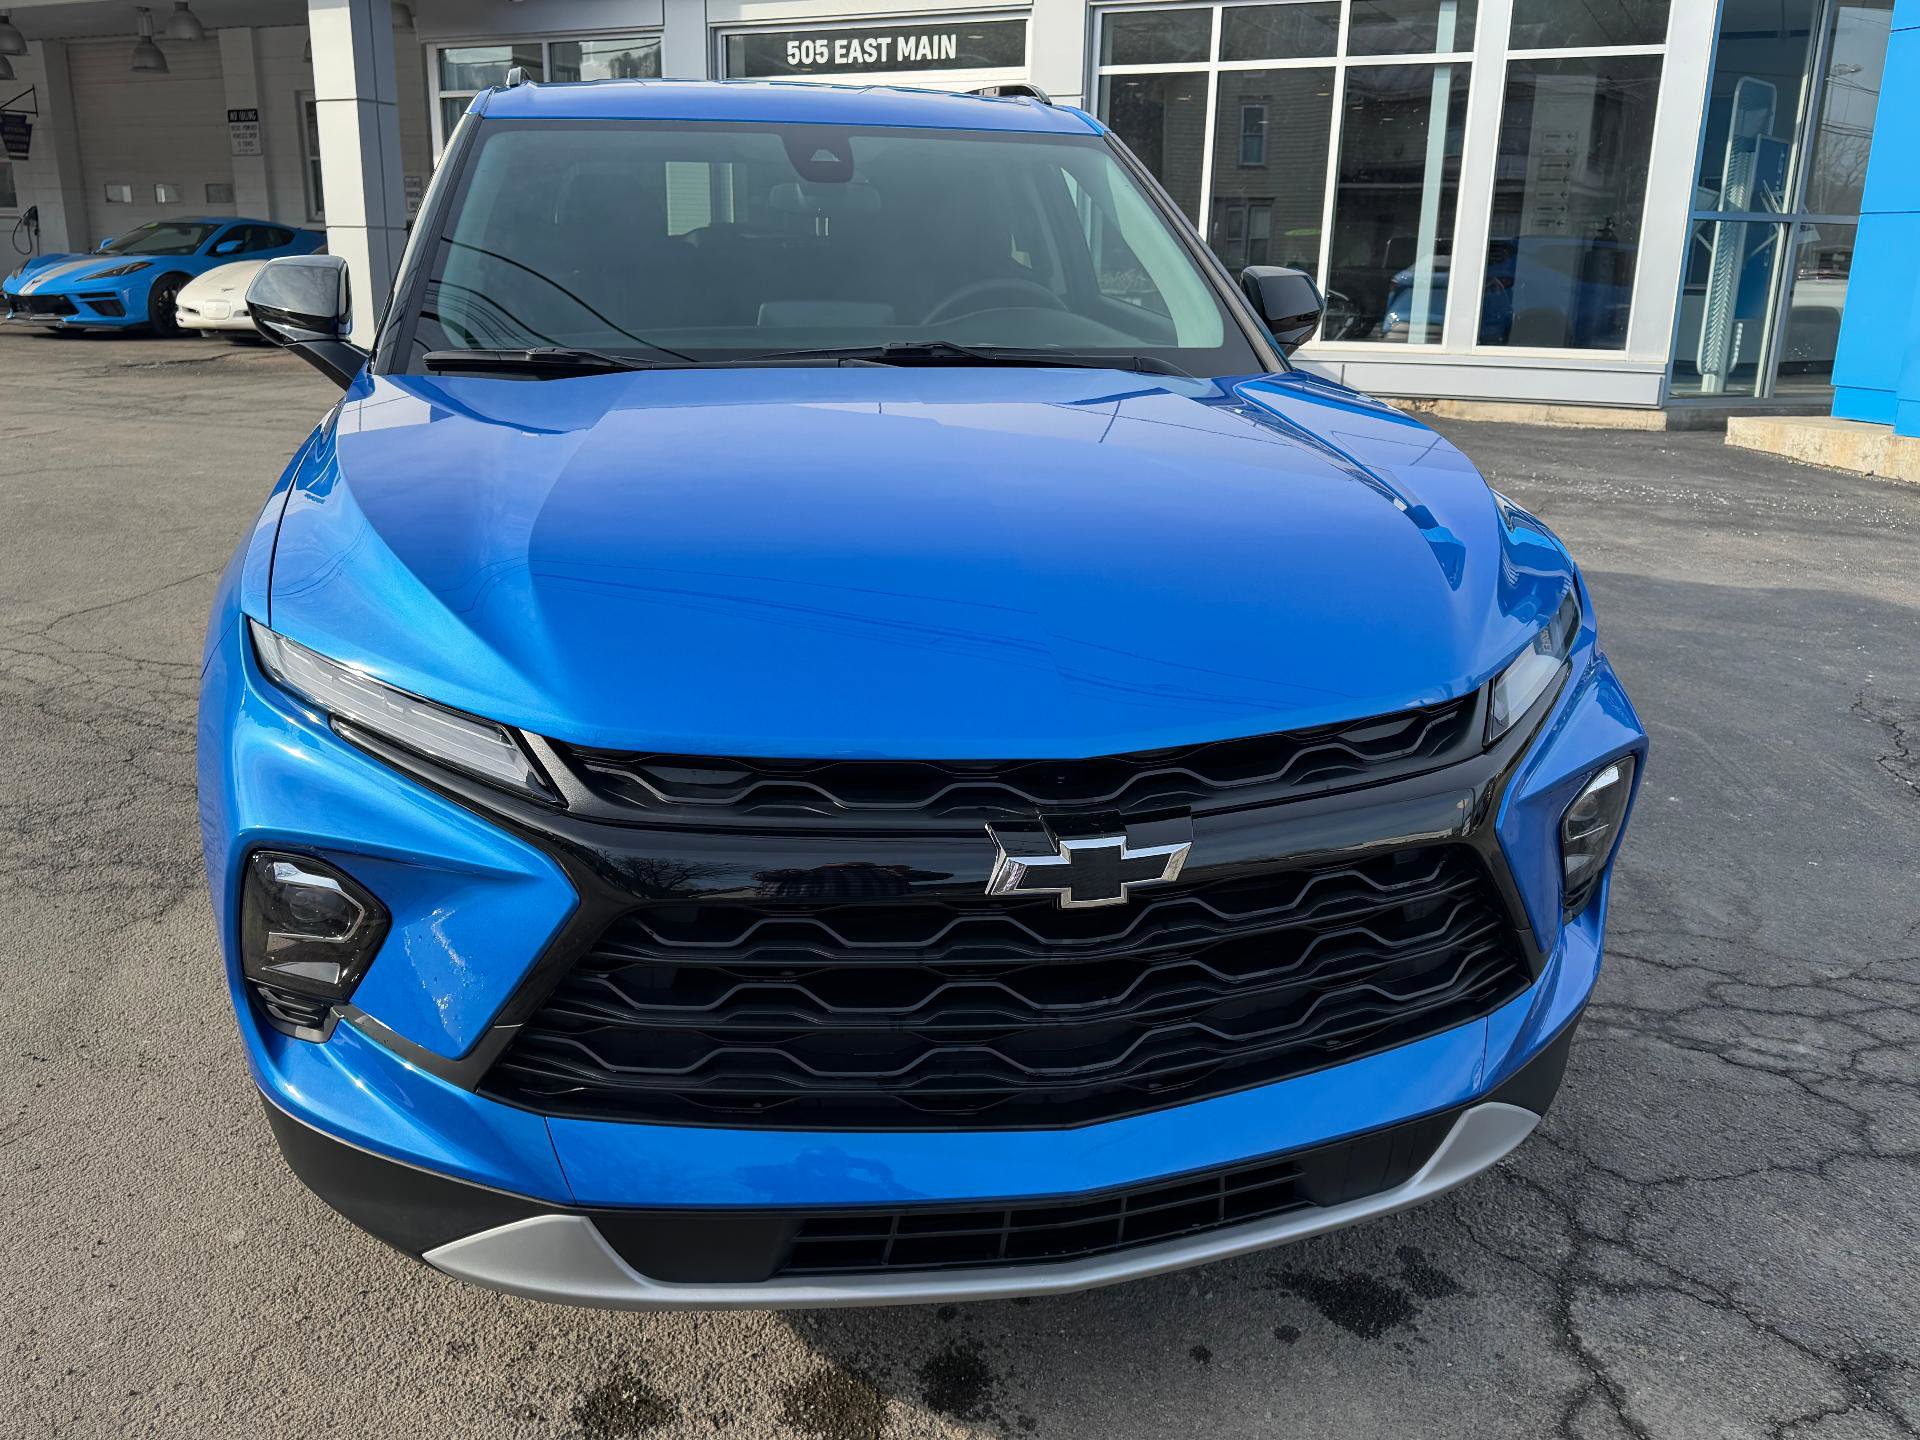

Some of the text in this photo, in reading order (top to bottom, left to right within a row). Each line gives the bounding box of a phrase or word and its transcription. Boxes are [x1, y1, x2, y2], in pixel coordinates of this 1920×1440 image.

[787, 34, 957, 65] 505 EAST MAIN
